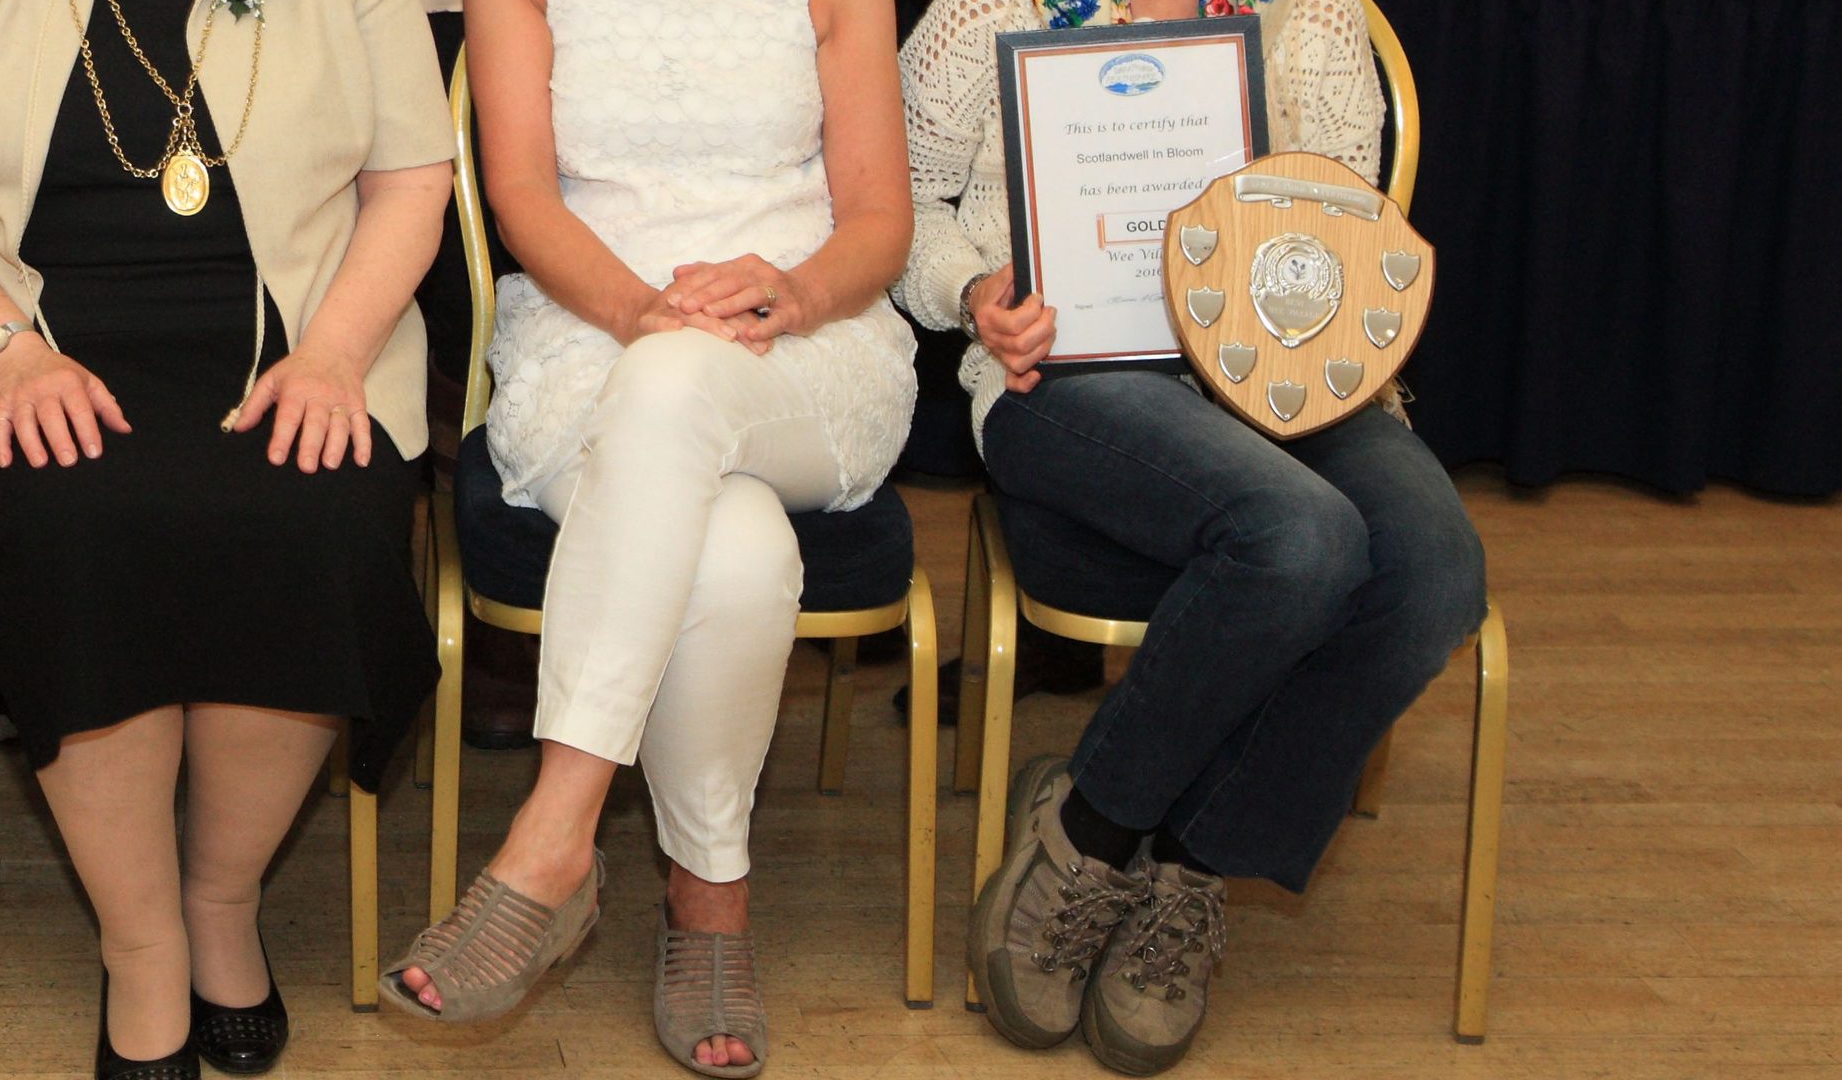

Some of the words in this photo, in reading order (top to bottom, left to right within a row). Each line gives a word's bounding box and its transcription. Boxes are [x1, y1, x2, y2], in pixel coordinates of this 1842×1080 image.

[1065, 122, 1092, 136] This
[1097, 121, 1107, 133] is
[1112, 120, 1125, 132] to
[1129, 116, 1176, 132] certify
[1180, 115, 1209, 128] that
[1076, 149, 1149, 164] Scotlandwell
[1153, 148, 1163, 160] In
[1167, 146, 1204, 159] Bloom
[1079, 184, 1102, 197] has
[1107, 182, 1137, 195] been
[1142, 176, 1204, 192] awarded
[1126, 219, 1167, 233] GOLD
[1106, 250, 1134, 262] Wee
